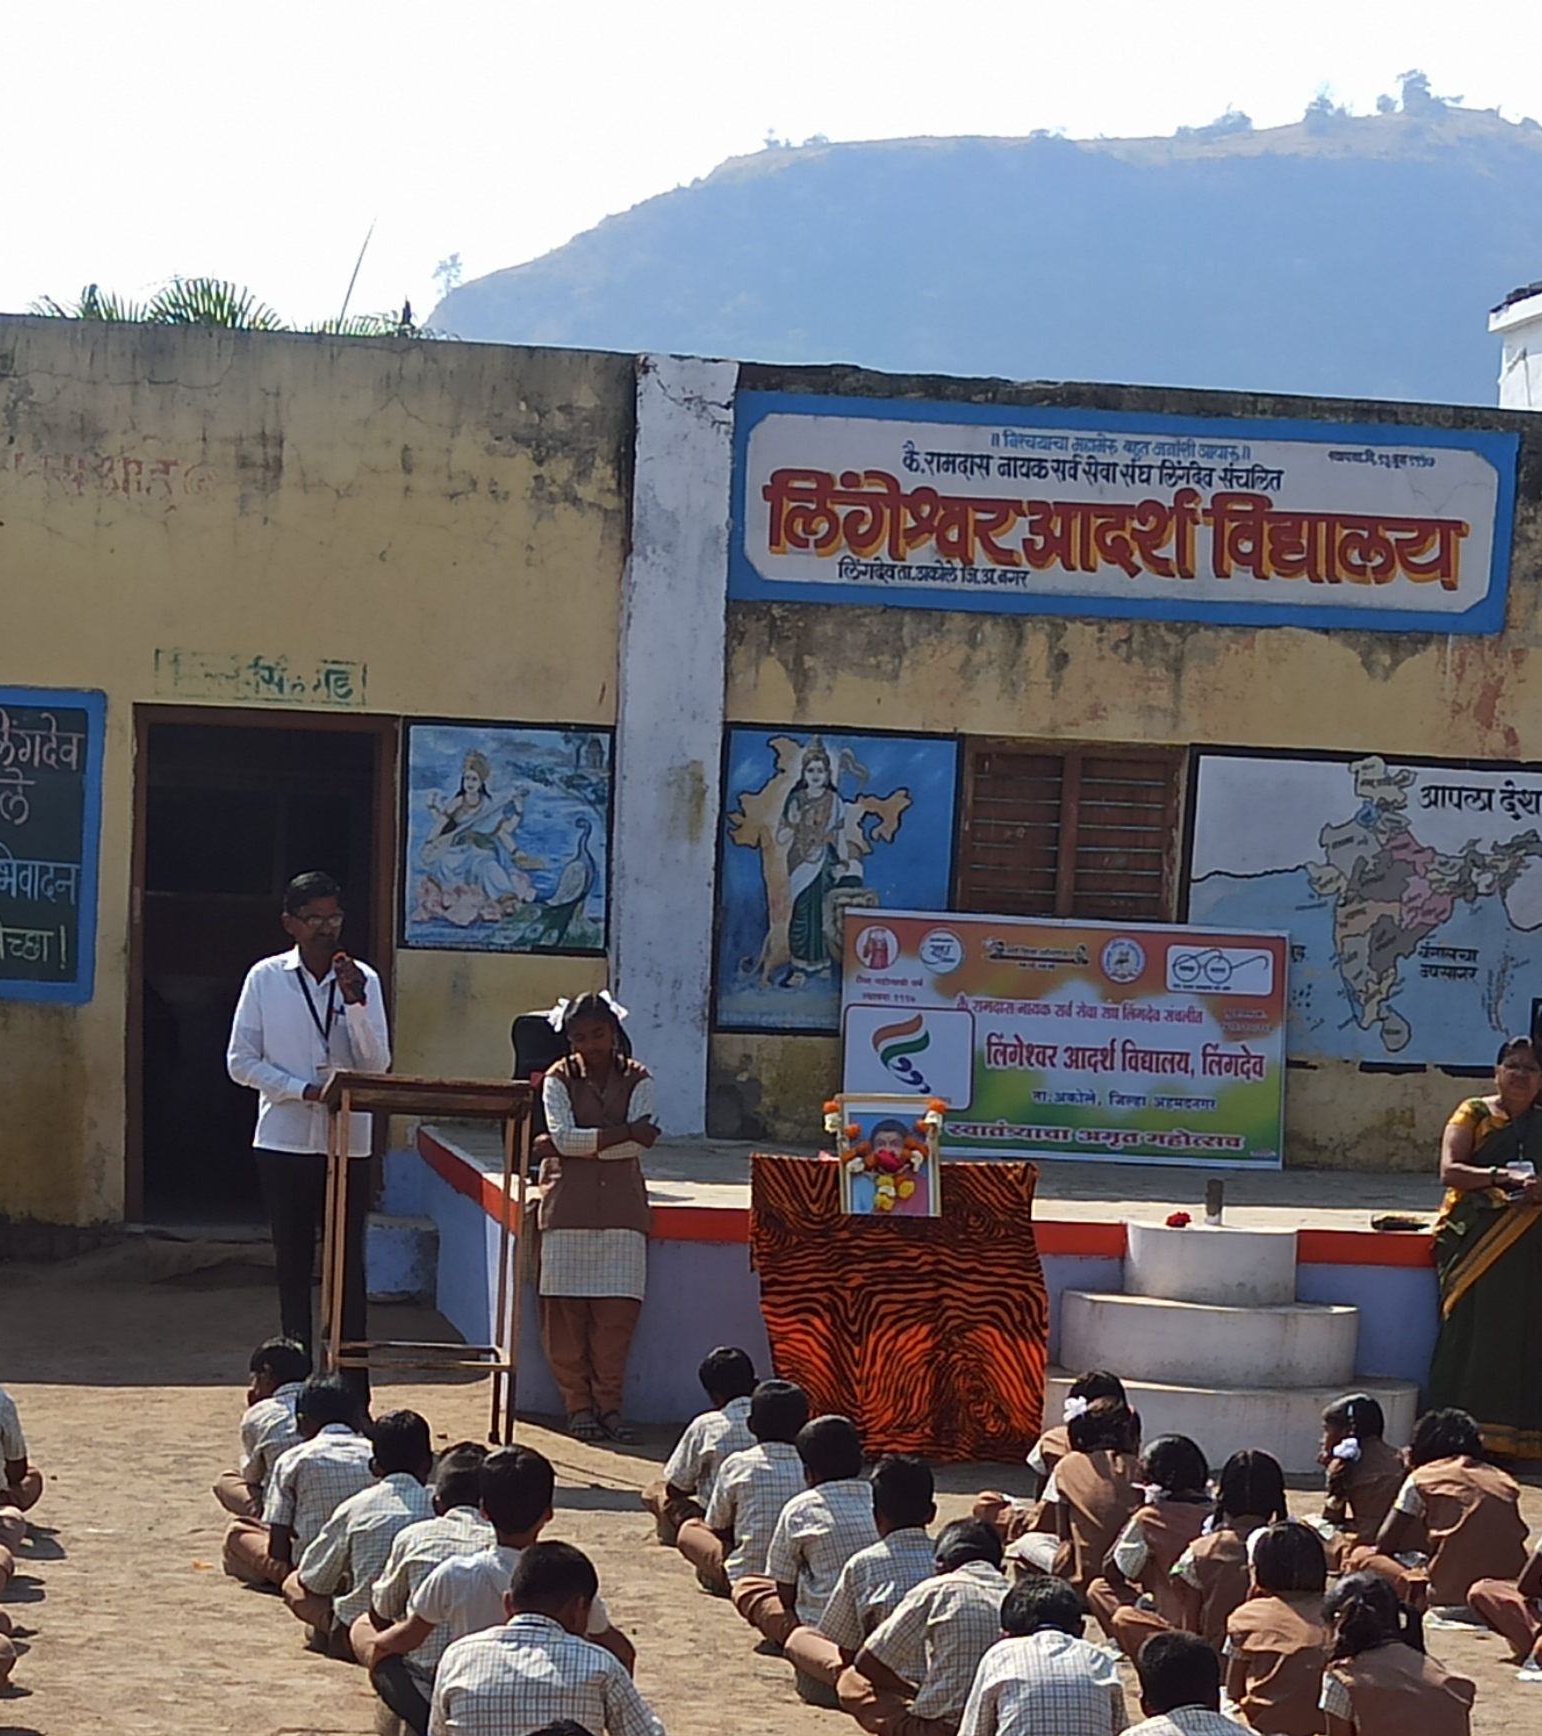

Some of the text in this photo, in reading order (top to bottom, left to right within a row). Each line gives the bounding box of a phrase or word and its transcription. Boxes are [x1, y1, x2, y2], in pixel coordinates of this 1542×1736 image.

[997, 455, 1049, 481] नायक
[1051, 451, 1080, 486] सर्व
[1081, 453, 1117, 486] सेवा
[1121, 452, 1153, 487] संघ
[1218, 460, 1286, 492] संचलित
[762, 468, 1470, 592] लिंगेश्वर आदर्श विद्यालय
[837, 555, 895, 583] लिंगदेव
[1418, 784, 1495, 812] आपला
[972, 999, 1014, 1016] रामदास
[1017, 1002, 1052, 1016] नायक
[1054, 1001, 1074, 1019] सर्व
[1076, 1001, 1098, 1020] सेवा
[986, 1032, 1266, 1082] लिंगेश्वर आदर्श विद्यालय, लिंगदेव
[1108, 1090, 1147, 1109] जिल्हा
[1154, 1096, 1218, 1111] अहमदनगर
[1077, 1128, 1141, 1149] अमृत
[1145, 1128, 1243, 1150] महोत्सव
